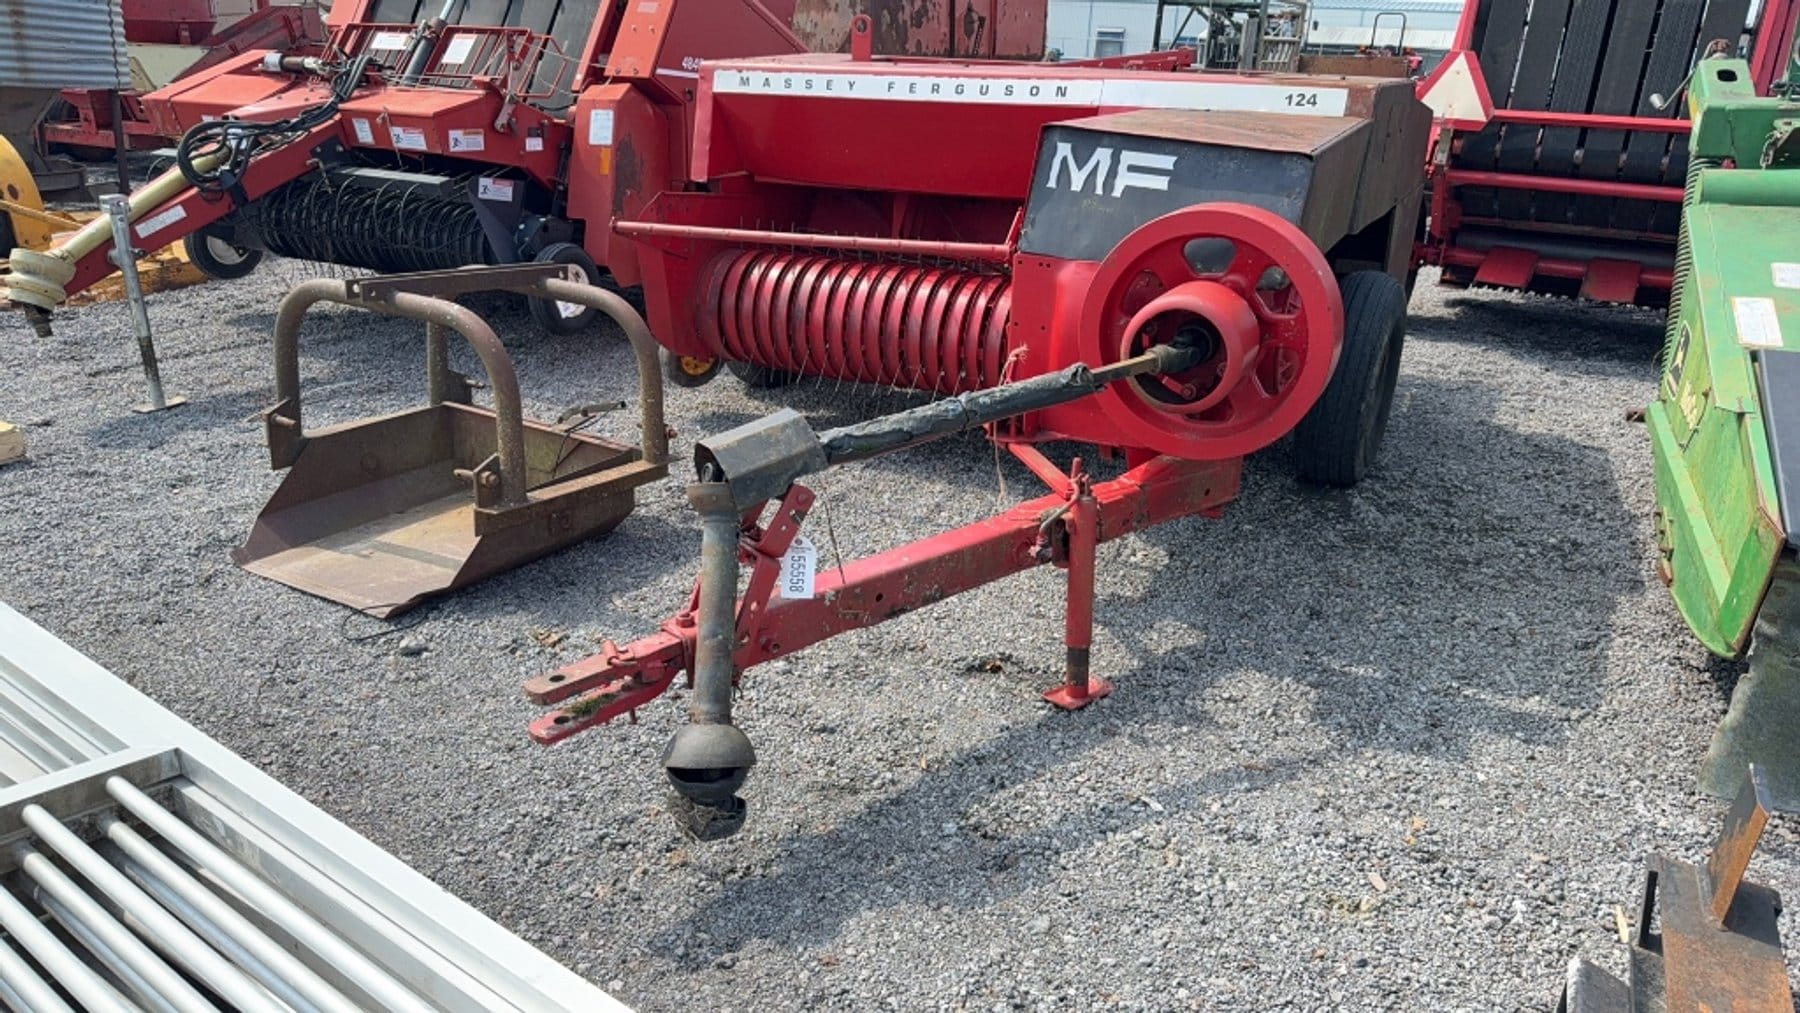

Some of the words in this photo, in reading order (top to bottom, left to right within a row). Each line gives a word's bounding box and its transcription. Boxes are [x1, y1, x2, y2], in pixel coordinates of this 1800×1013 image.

[738, 76, 856, 91] MASSEY
[887, 81, 1068, 98] FERGUSON
[1284, 93, 1318, 107] 124
[1046, 142, 1178, 198] MF
